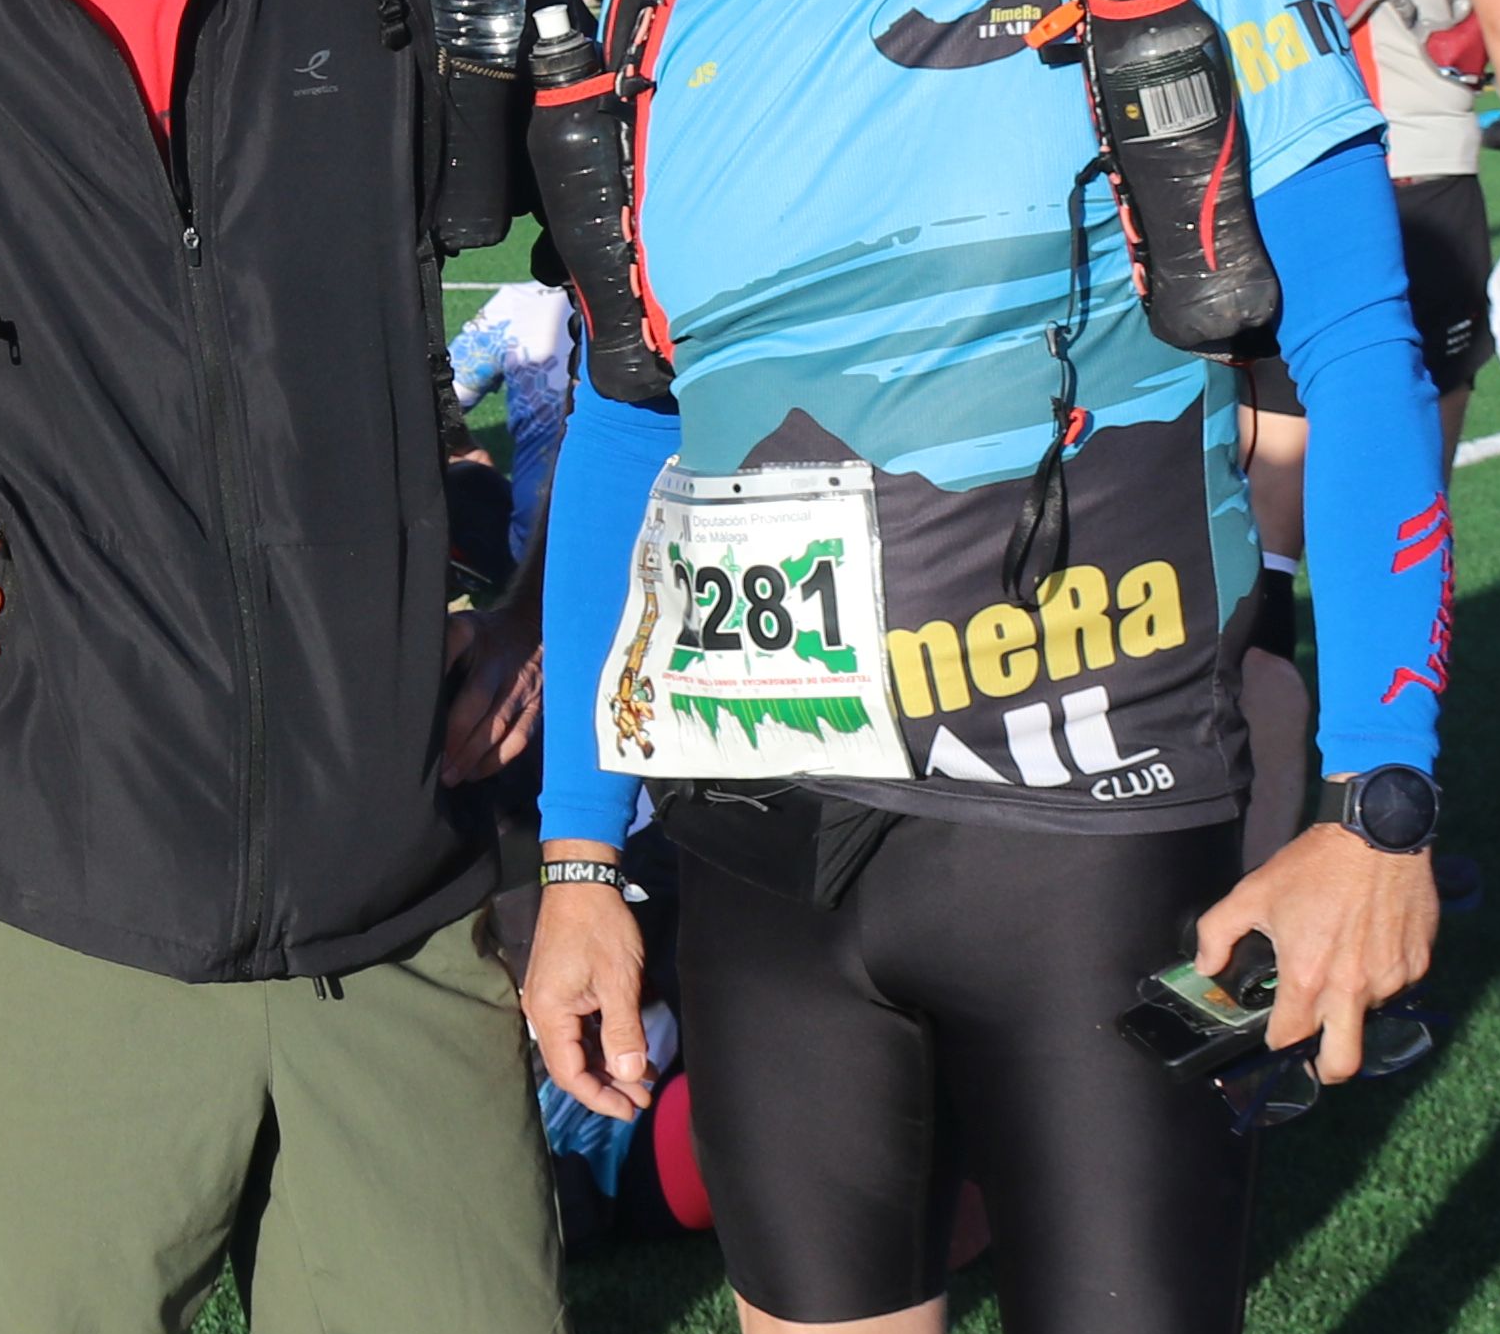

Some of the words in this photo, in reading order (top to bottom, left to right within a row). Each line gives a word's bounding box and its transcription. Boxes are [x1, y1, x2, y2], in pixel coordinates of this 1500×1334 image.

[692, 513, 747, 529] Diputación
[1091, 762, 1176, 801] CLUB
[564, 863, 594, 881] KM
